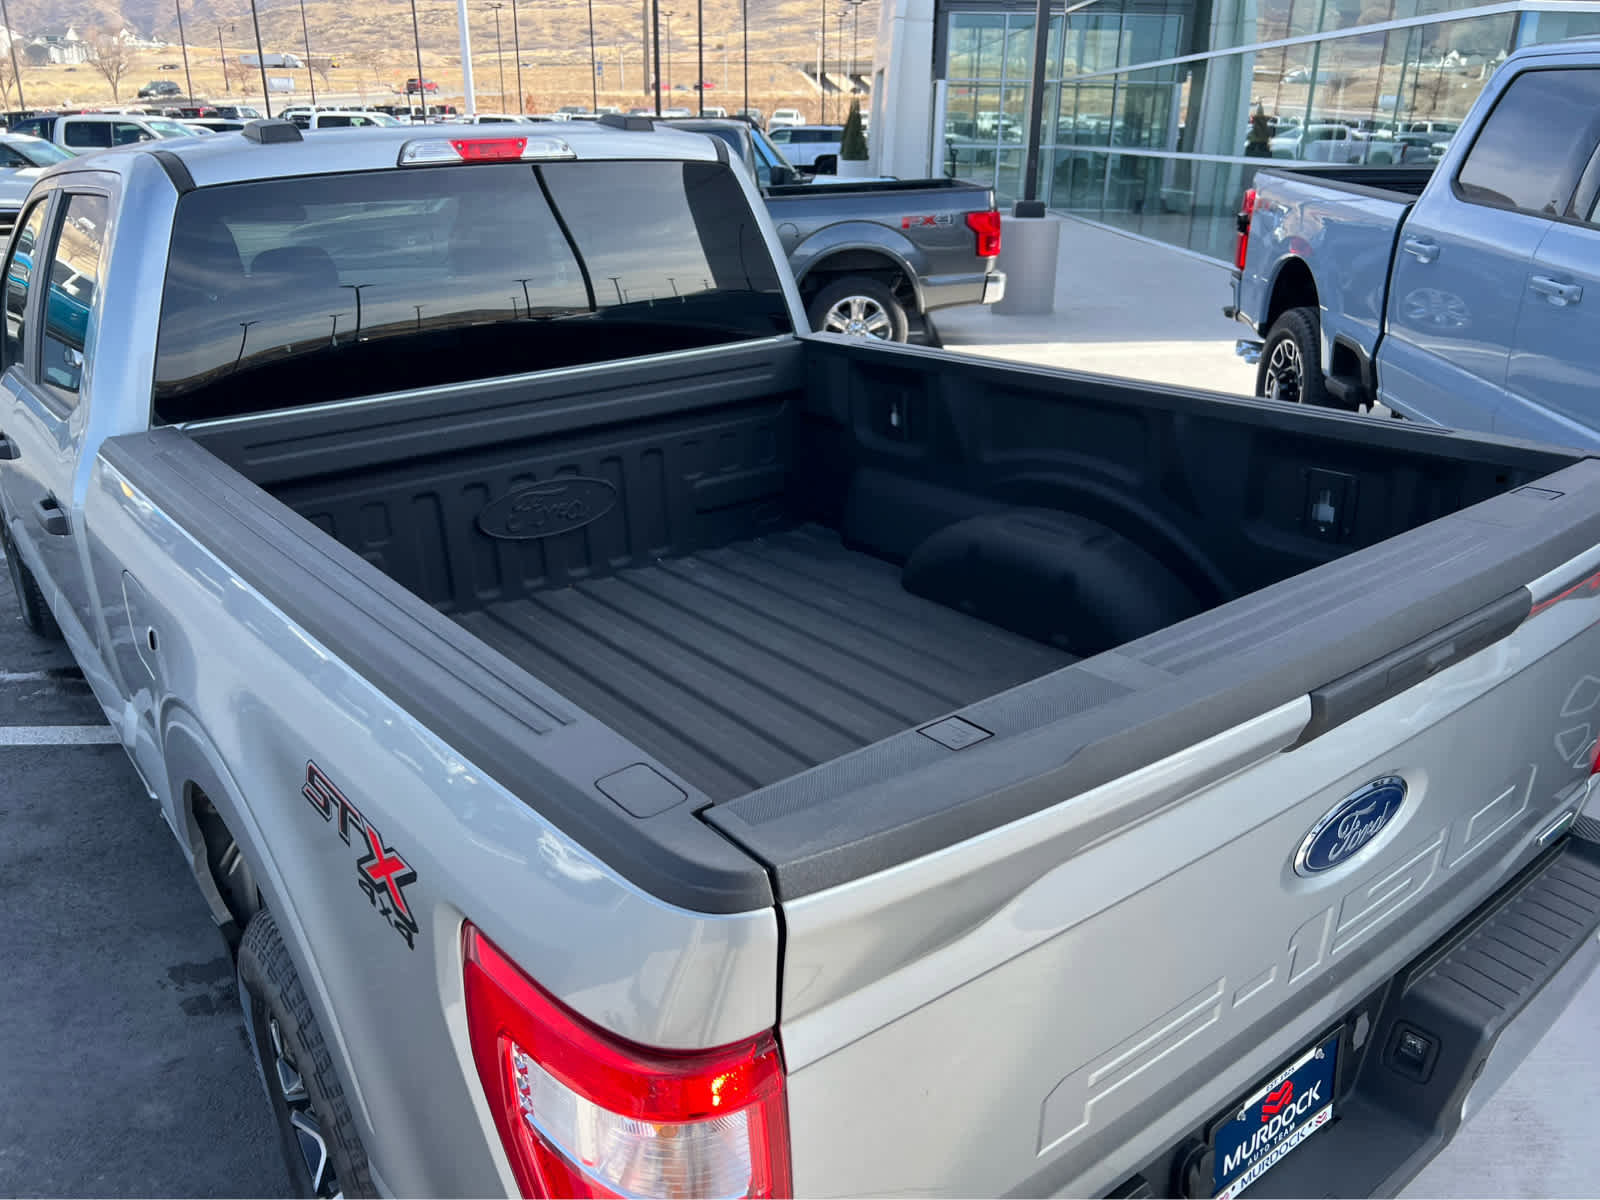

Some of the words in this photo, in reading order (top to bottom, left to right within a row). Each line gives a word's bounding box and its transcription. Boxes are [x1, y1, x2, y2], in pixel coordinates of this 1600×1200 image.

[301, 759, 419, 934] STX
[1327, 800, 1391, 861] Ford
[1035, 763, 1537, 1159] F-150
[1222, 1079, 1322, 1177] MURDOCK
[1239, 1126, 1307, 1190] MURDOCK
[1247, 1143, 1270, 1167] AUTO
[1273, 1122, 1296, 1145] TEAM
